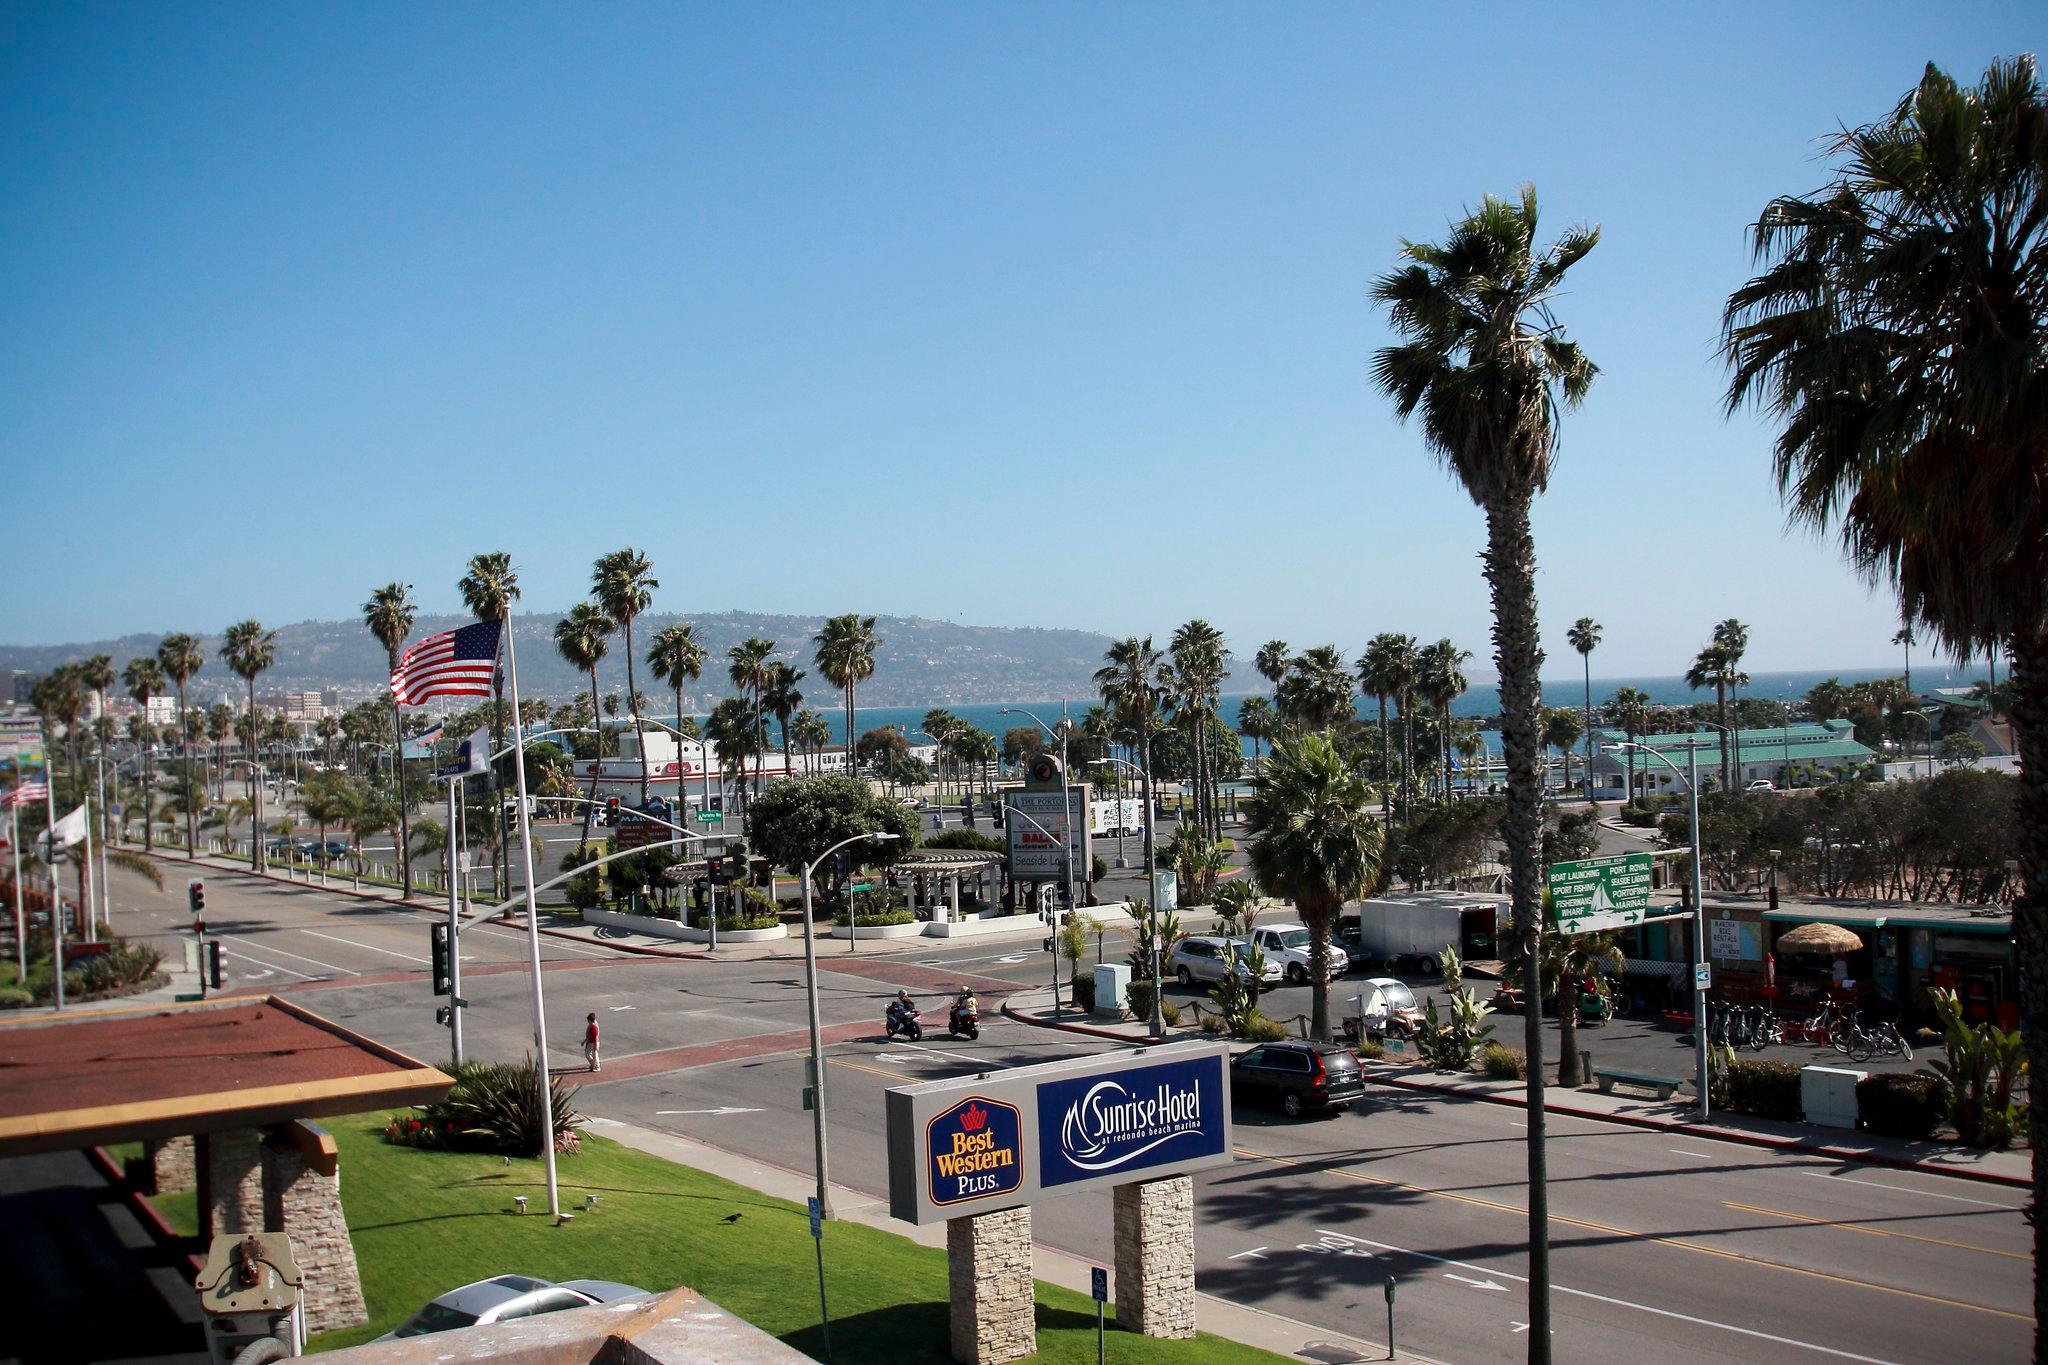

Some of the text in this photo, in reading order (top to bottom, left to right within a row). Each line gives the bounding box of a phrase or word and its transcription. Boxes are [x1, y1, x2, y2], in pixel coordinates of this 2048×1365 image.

[1015, 855, 1048, 866] Seaside
[1609, 863, 1650, 875] PORT ROYAL
[1550, 869, 1600, 882] BOAT LAUNCHING
[1611, 874, 1650, 886] SEASIDE LAGOON
[1553, 883, 1596, 895] SPORT FISHING
[1612, 886, 1648, 898] PORTOFINO
[1556, 896, 1592, 908] FISHERMANS
[1615, 898, 1646, 909] MARINAS
[1561, 907, 1585, 917] WHARF
[1713, 934, 1737, 942] RENTALS
[1092, 1078, 1200, 1137] Sunrise Hotel
[1102, 1120, 1201, 1145] at redondo beach marina
[951, 1127, 995, 1155] Best
[936, 1148, 1014, 1177] Western
[957, 1174, 996, 1195] PLUS
